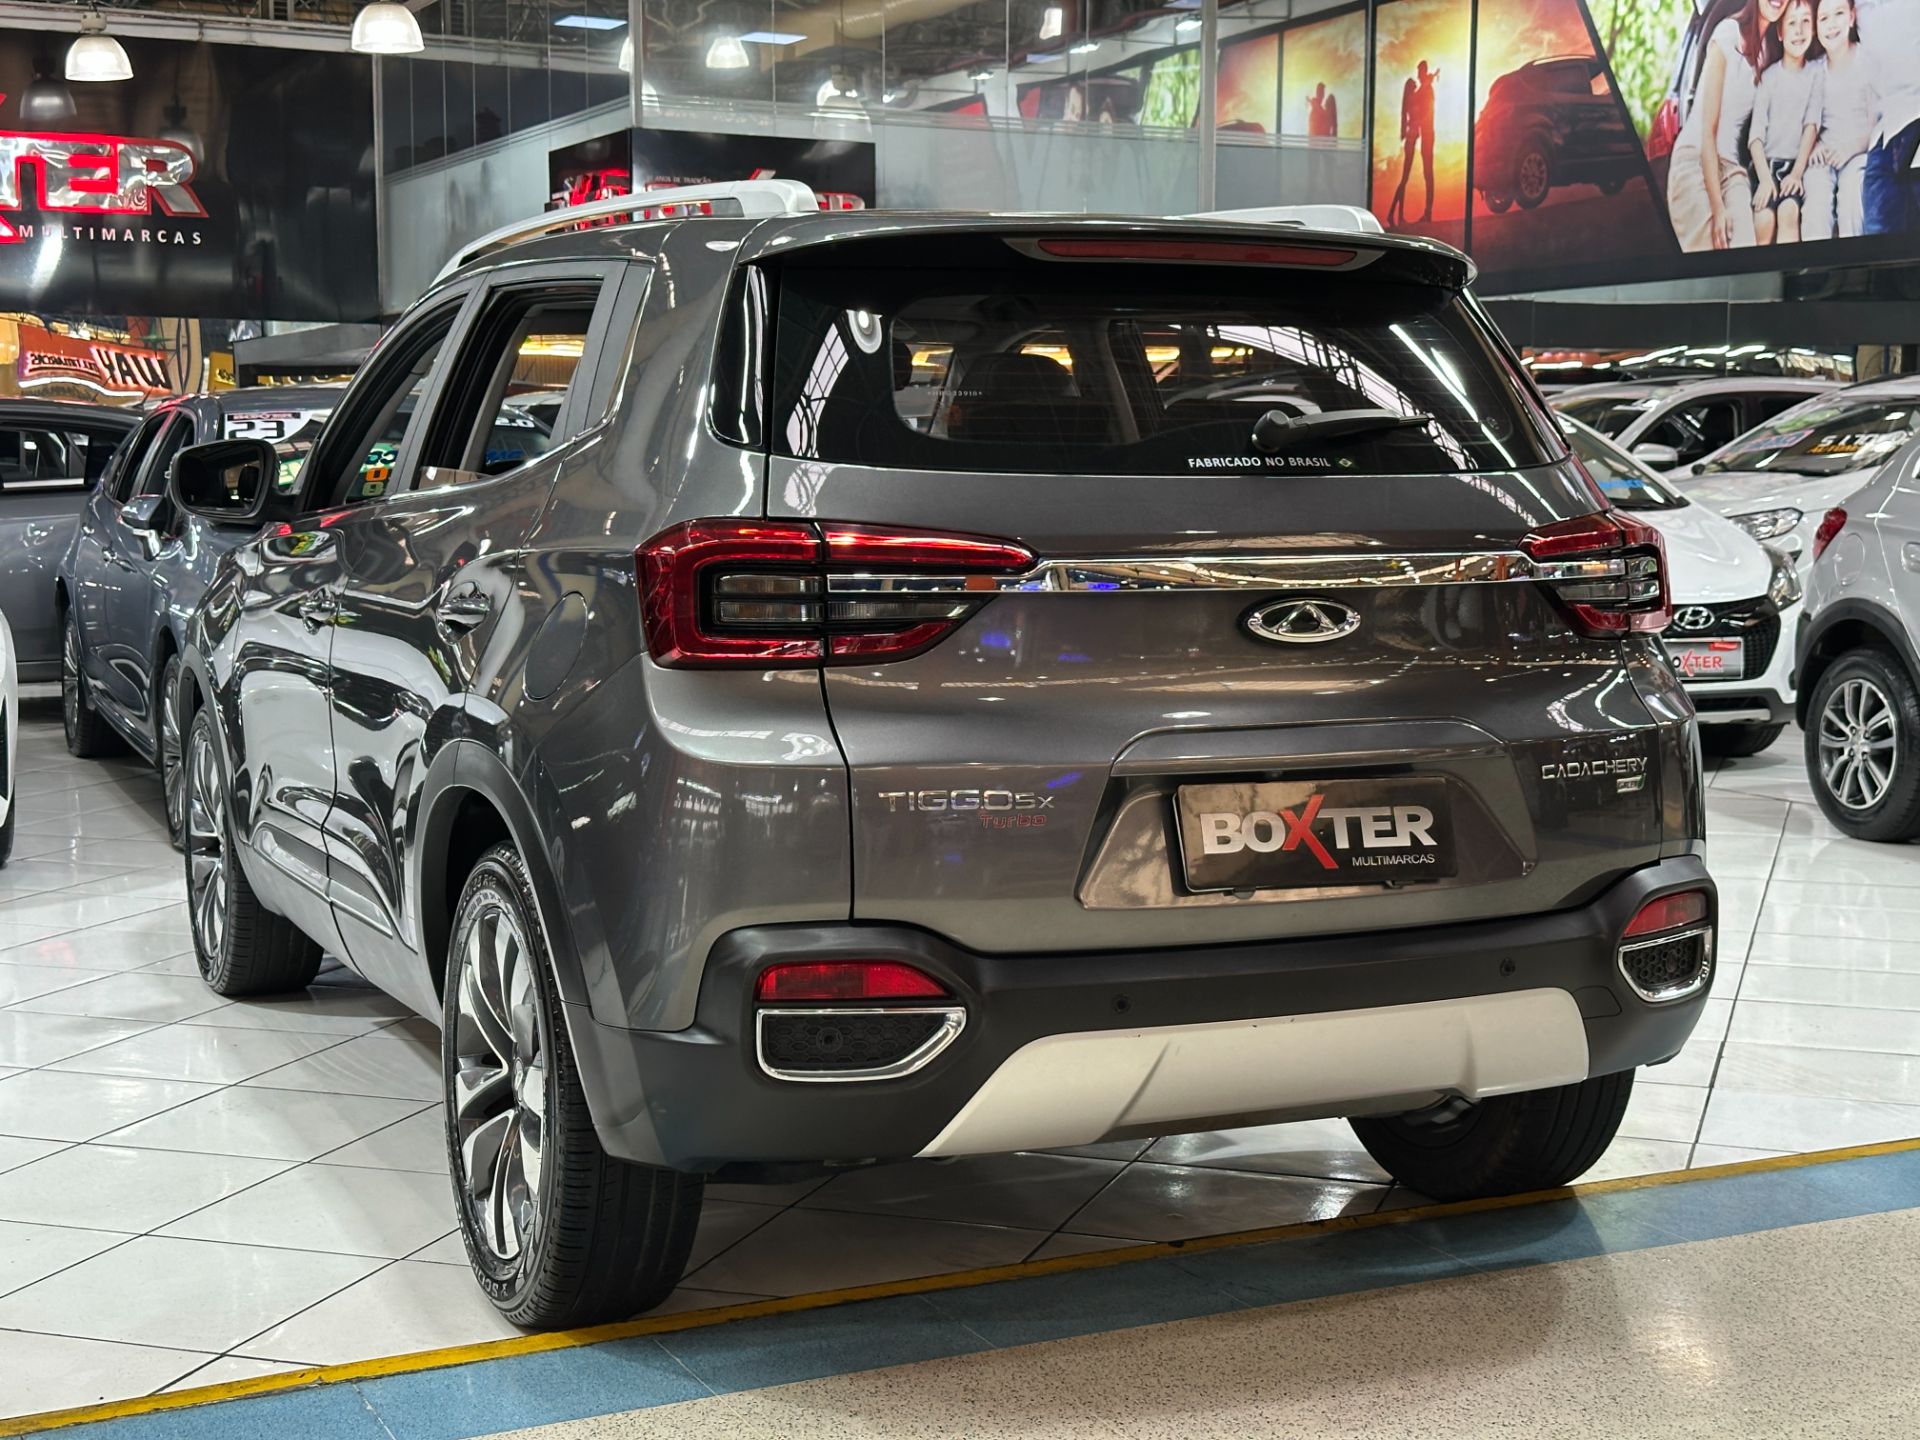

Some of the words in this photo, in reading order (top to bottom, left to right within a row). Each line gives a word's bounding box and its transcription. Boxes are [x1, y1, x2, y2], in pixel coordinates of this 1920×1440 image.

[0, 112, 209, 240] TER
[19, 224, 201, 245] MULTIMARCAS
[228, 420, 286, 440] 23
[1187, 456, 1262, 468] FABRICADO
[1265, 456, 1285, 467] NO
[1288, 456, 1332, 468] BRASIL
[1200, 793, 1438, 869] BOXTER
[1351, 852, 1436, 867] MULTIMARCAS
